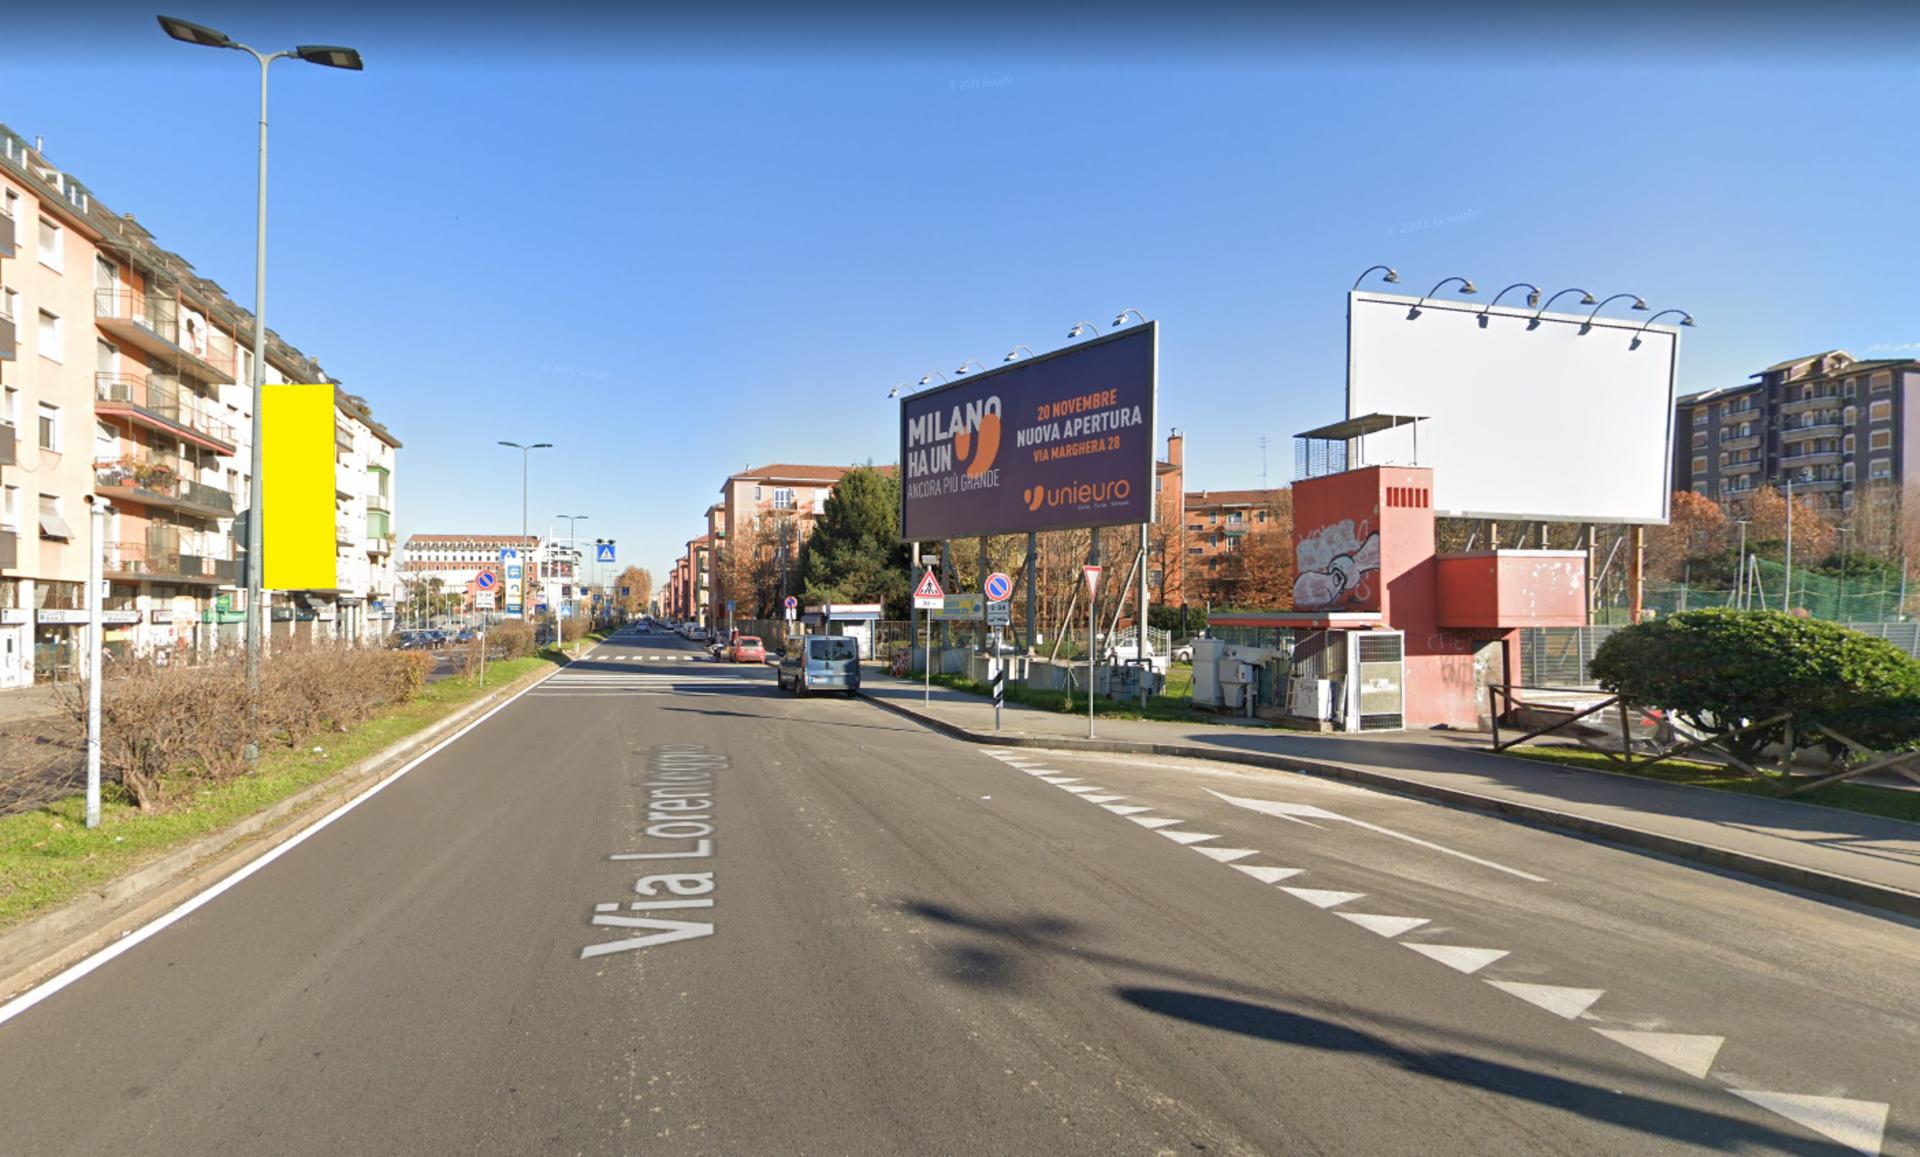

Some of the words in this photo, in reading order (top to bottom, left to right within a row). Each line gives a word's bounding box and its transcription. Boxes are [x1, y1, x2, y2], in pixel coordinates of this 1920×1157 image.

[1037, 404, 1050, 421] 20
[1052, 387, 1118, 418] NOVEMBRE
[908, 395, 1002, 448] MILANO
[1016, 422, 1061, 448] NUOVA
[1063, 404, 1143, 439] APERTURA
[908, 449, 929, 479] HA
[930, 443, 952, 474] UN
[1032, 447, 1050, 464] VIA
[1051, 439, 1106, 461] MARGHERA
[907, 480, 942, 500] ANCORA
[943, 472, 958, 494] PIÙ
[960, 468, 1001, 492] GRANDE
[1047, 479, 1131, 507] unieuro
